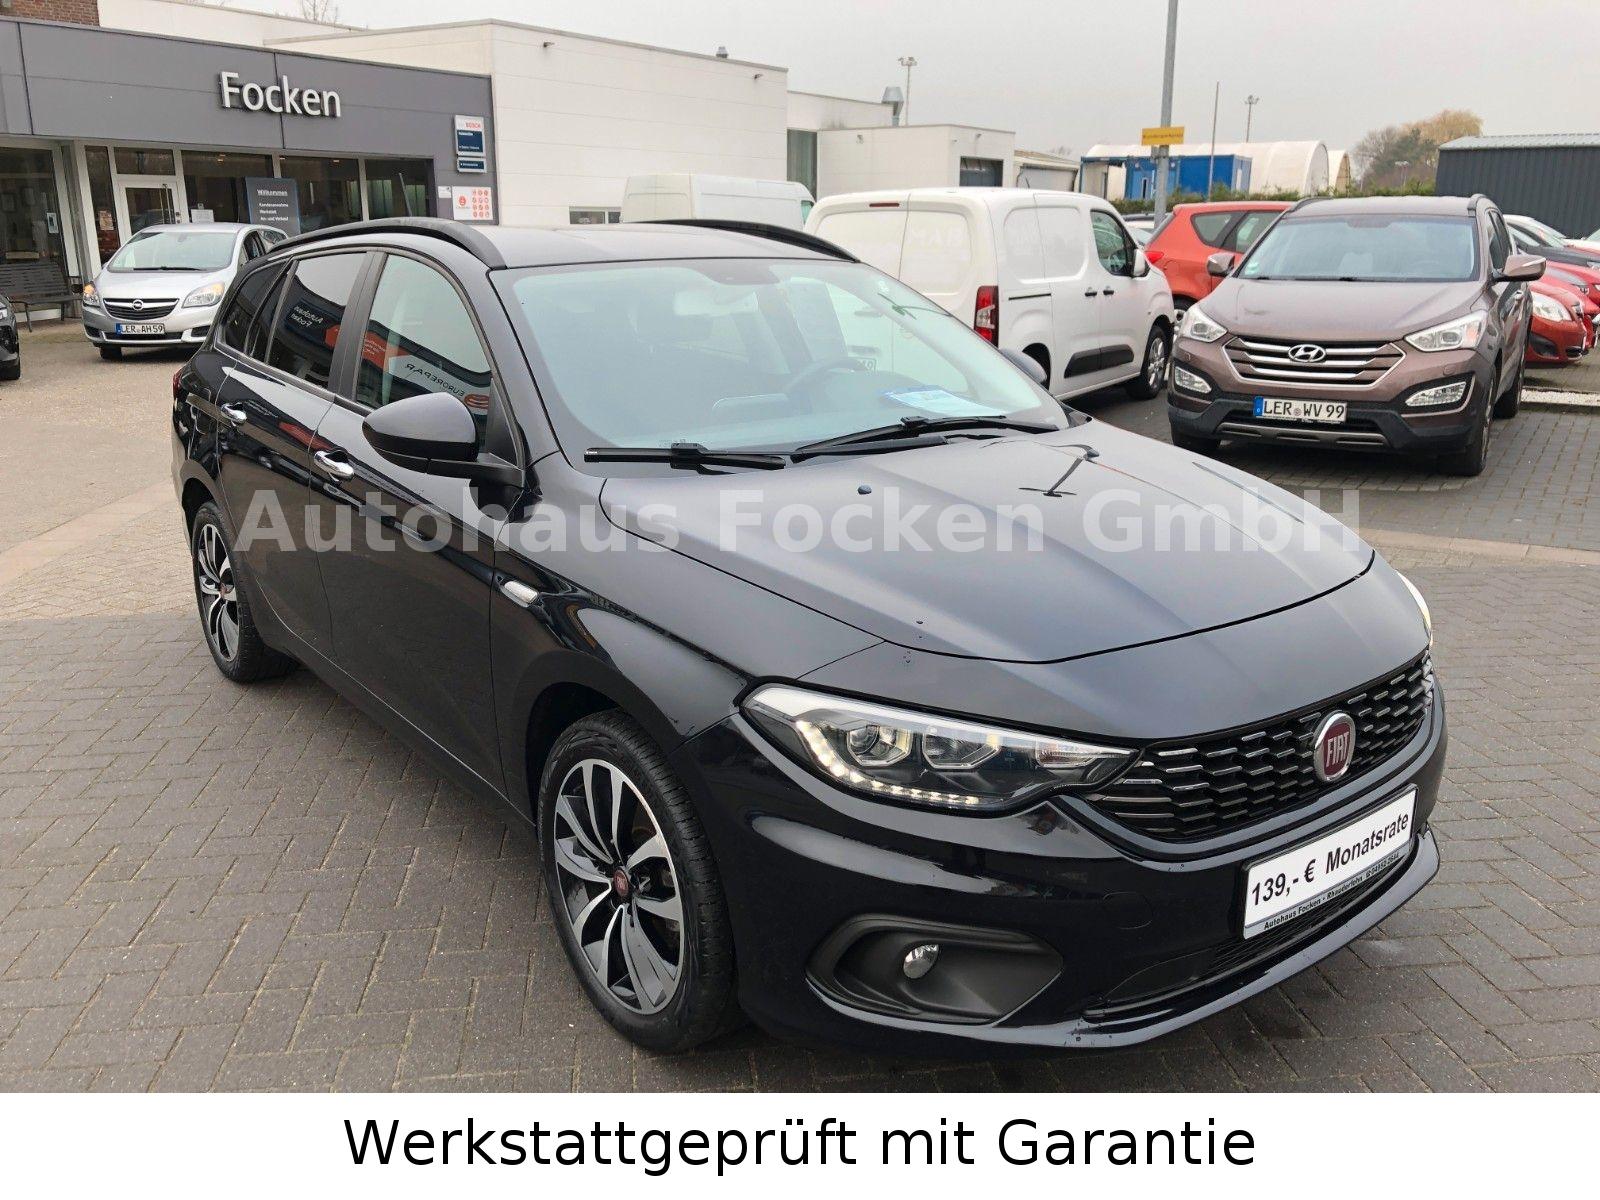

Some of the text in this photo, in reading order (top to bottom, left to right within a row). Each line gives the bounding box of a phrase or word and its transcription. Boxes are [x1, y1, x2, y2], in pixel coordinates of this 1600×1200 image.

[220, 71, 341, 117] Focken
[1264, 400, 1345, 419] LER WV 99
[1326, 731, 1350, 768] FIAT
[1304, 859, 1316, 883] €
[1325, 813, 1409, 875] Monatsrate
[1264, 910, 1297, 930] Autohaus
[1298, 898, 1321, 914] Focken
